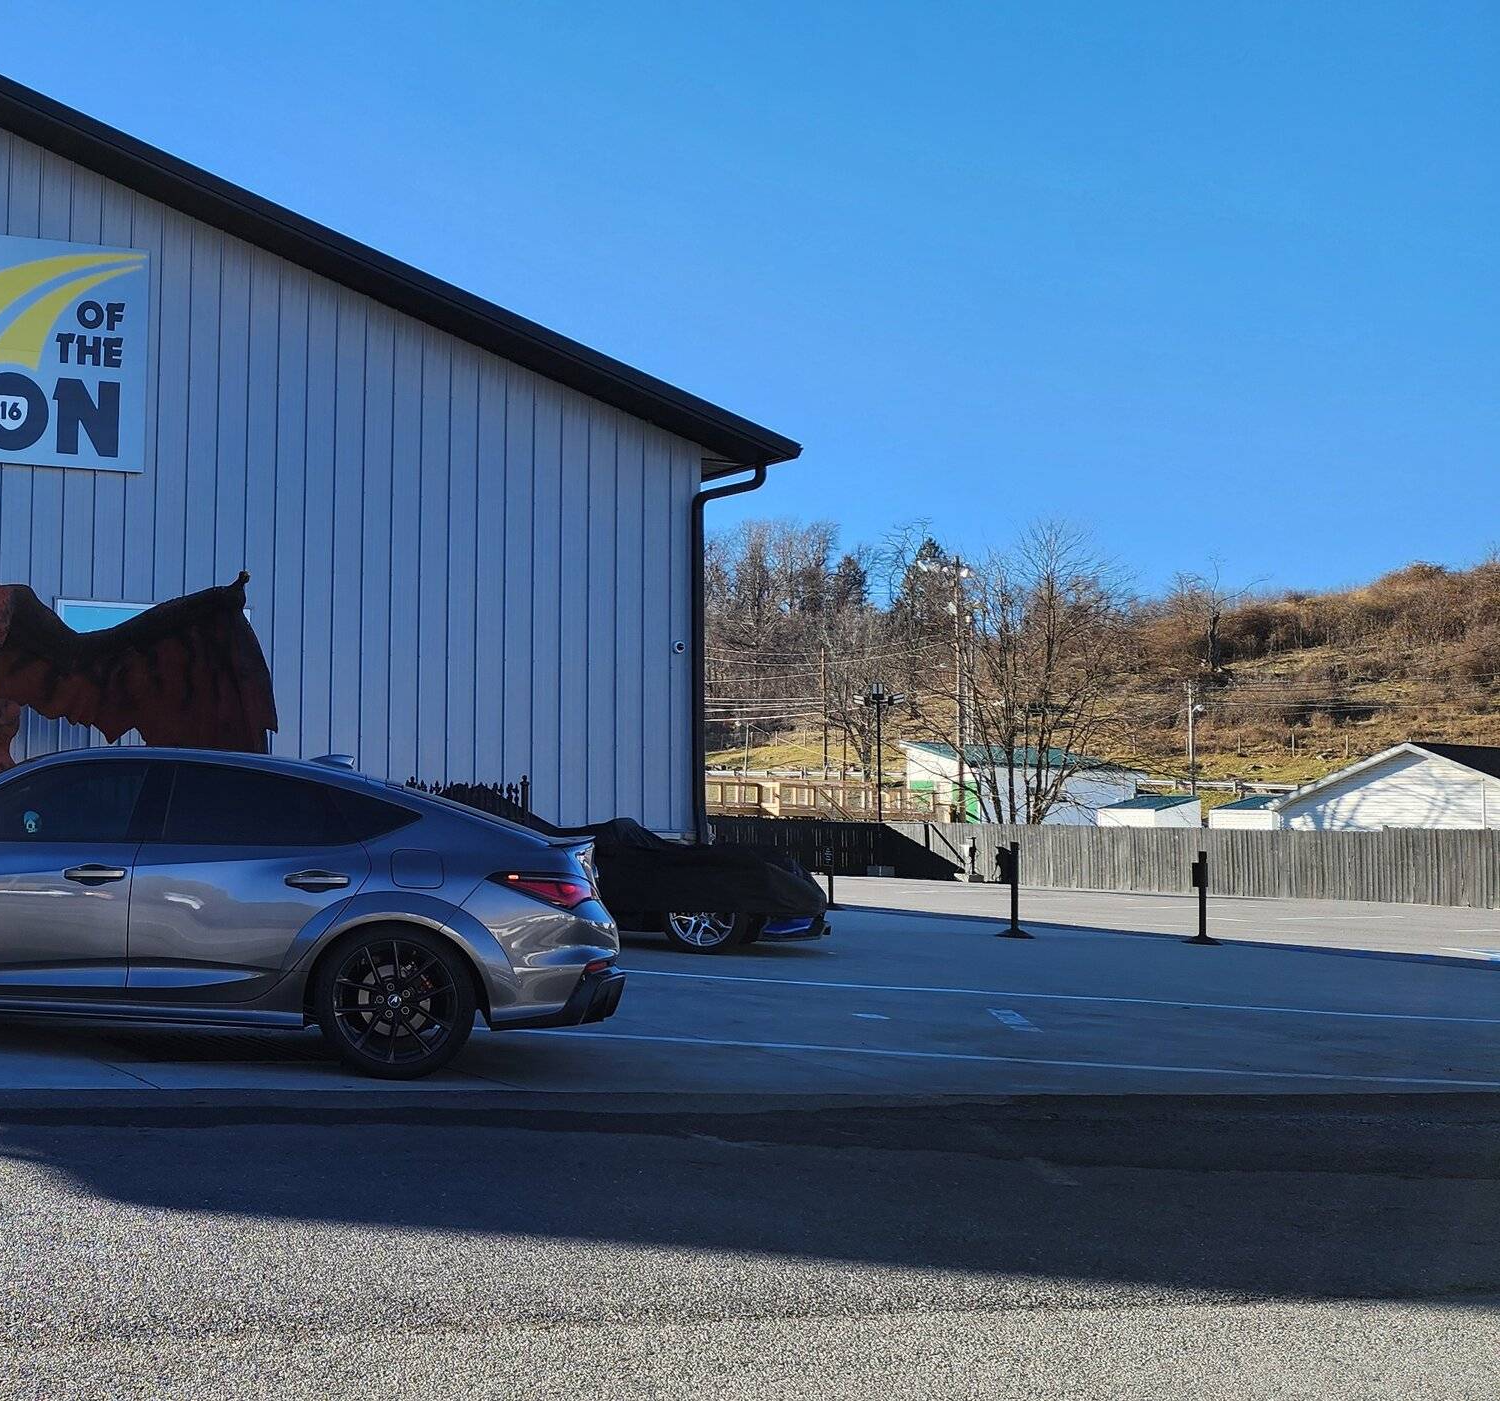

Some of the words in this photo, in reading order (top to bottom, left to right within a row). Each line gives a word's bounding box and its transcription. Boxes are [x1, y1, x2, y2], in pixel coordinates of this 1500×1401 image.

[76, 300, 125, 332] OF
[55, 332, 124, 369] THE
[0, 400, 23, 421] 16
